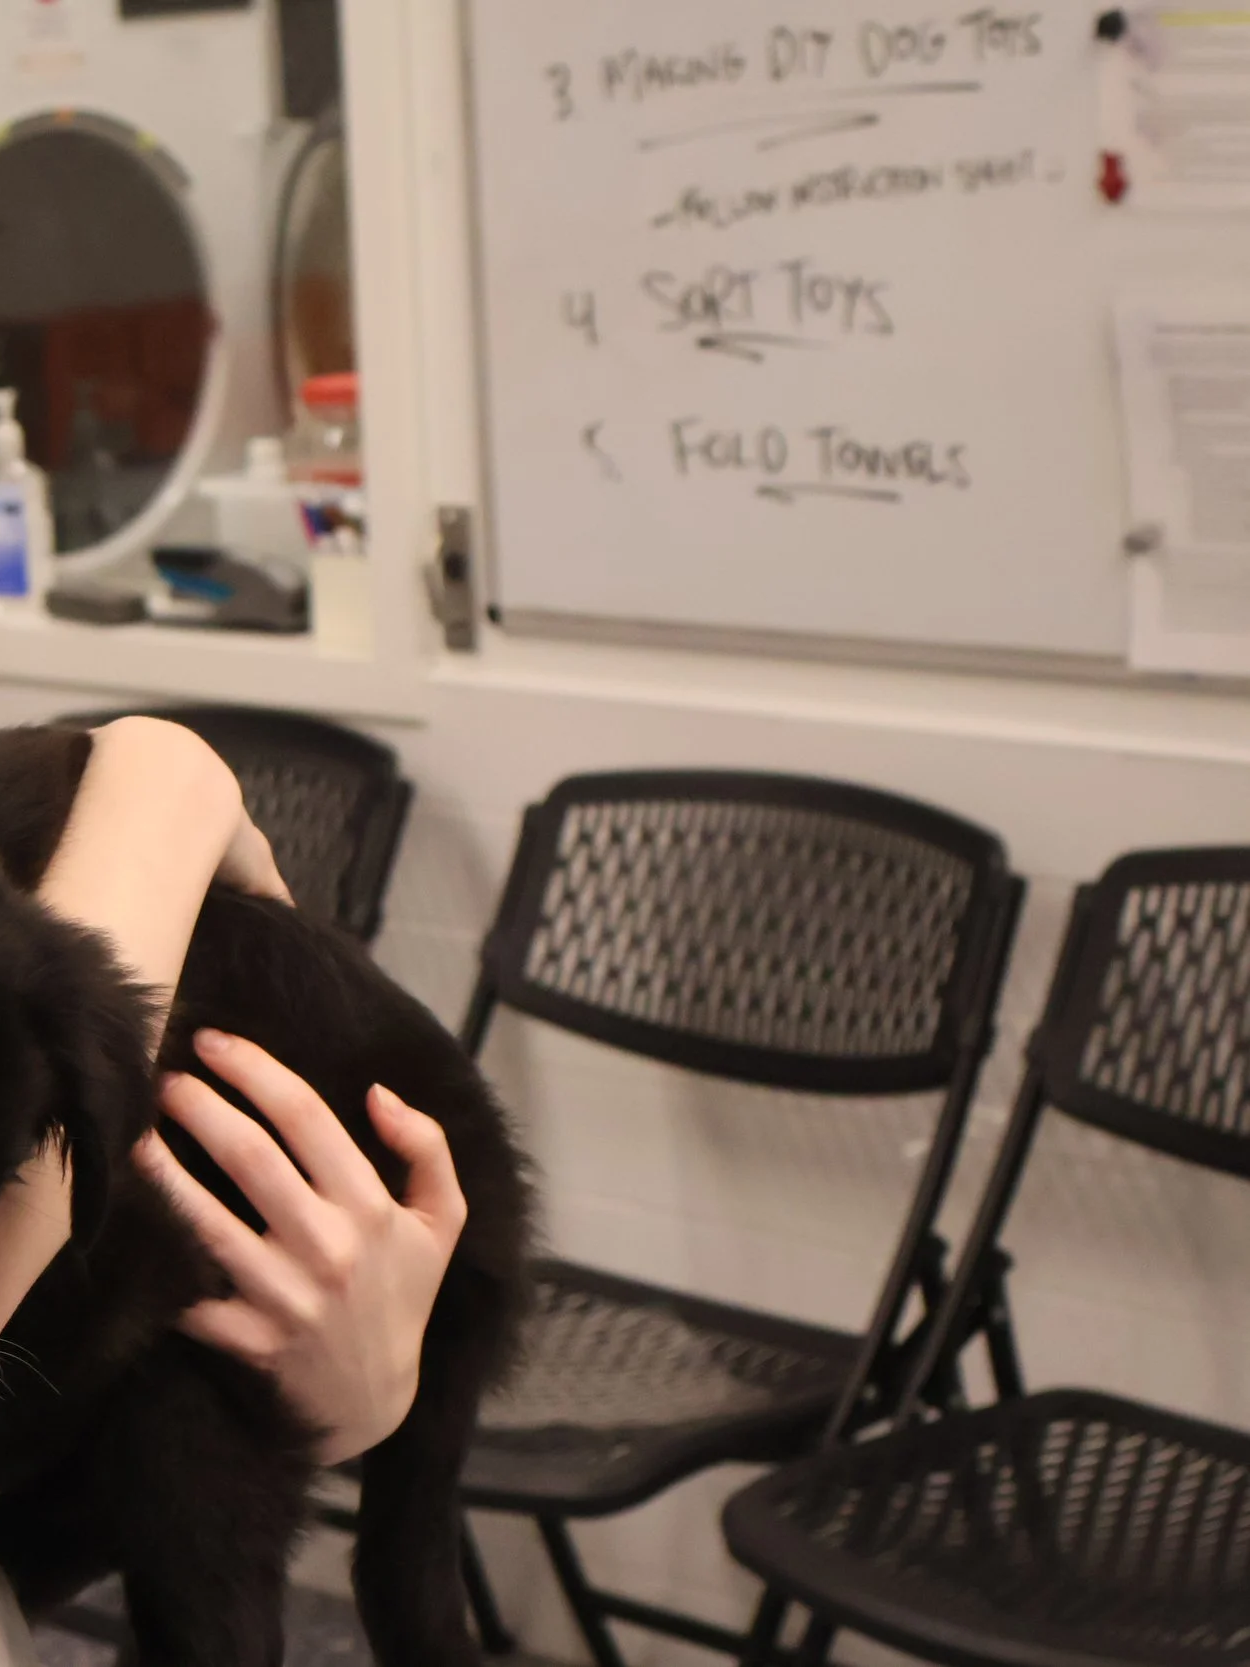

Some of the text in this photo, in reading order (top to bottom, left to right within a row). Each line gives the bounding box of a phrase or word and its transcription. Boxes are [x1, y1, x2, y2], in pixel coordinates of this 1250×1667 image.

[857, 18, 948, 79] DOG
[561, 256, 896, 347] 4 SORT TOYS
[670, 414, 789, 479] FOLD
